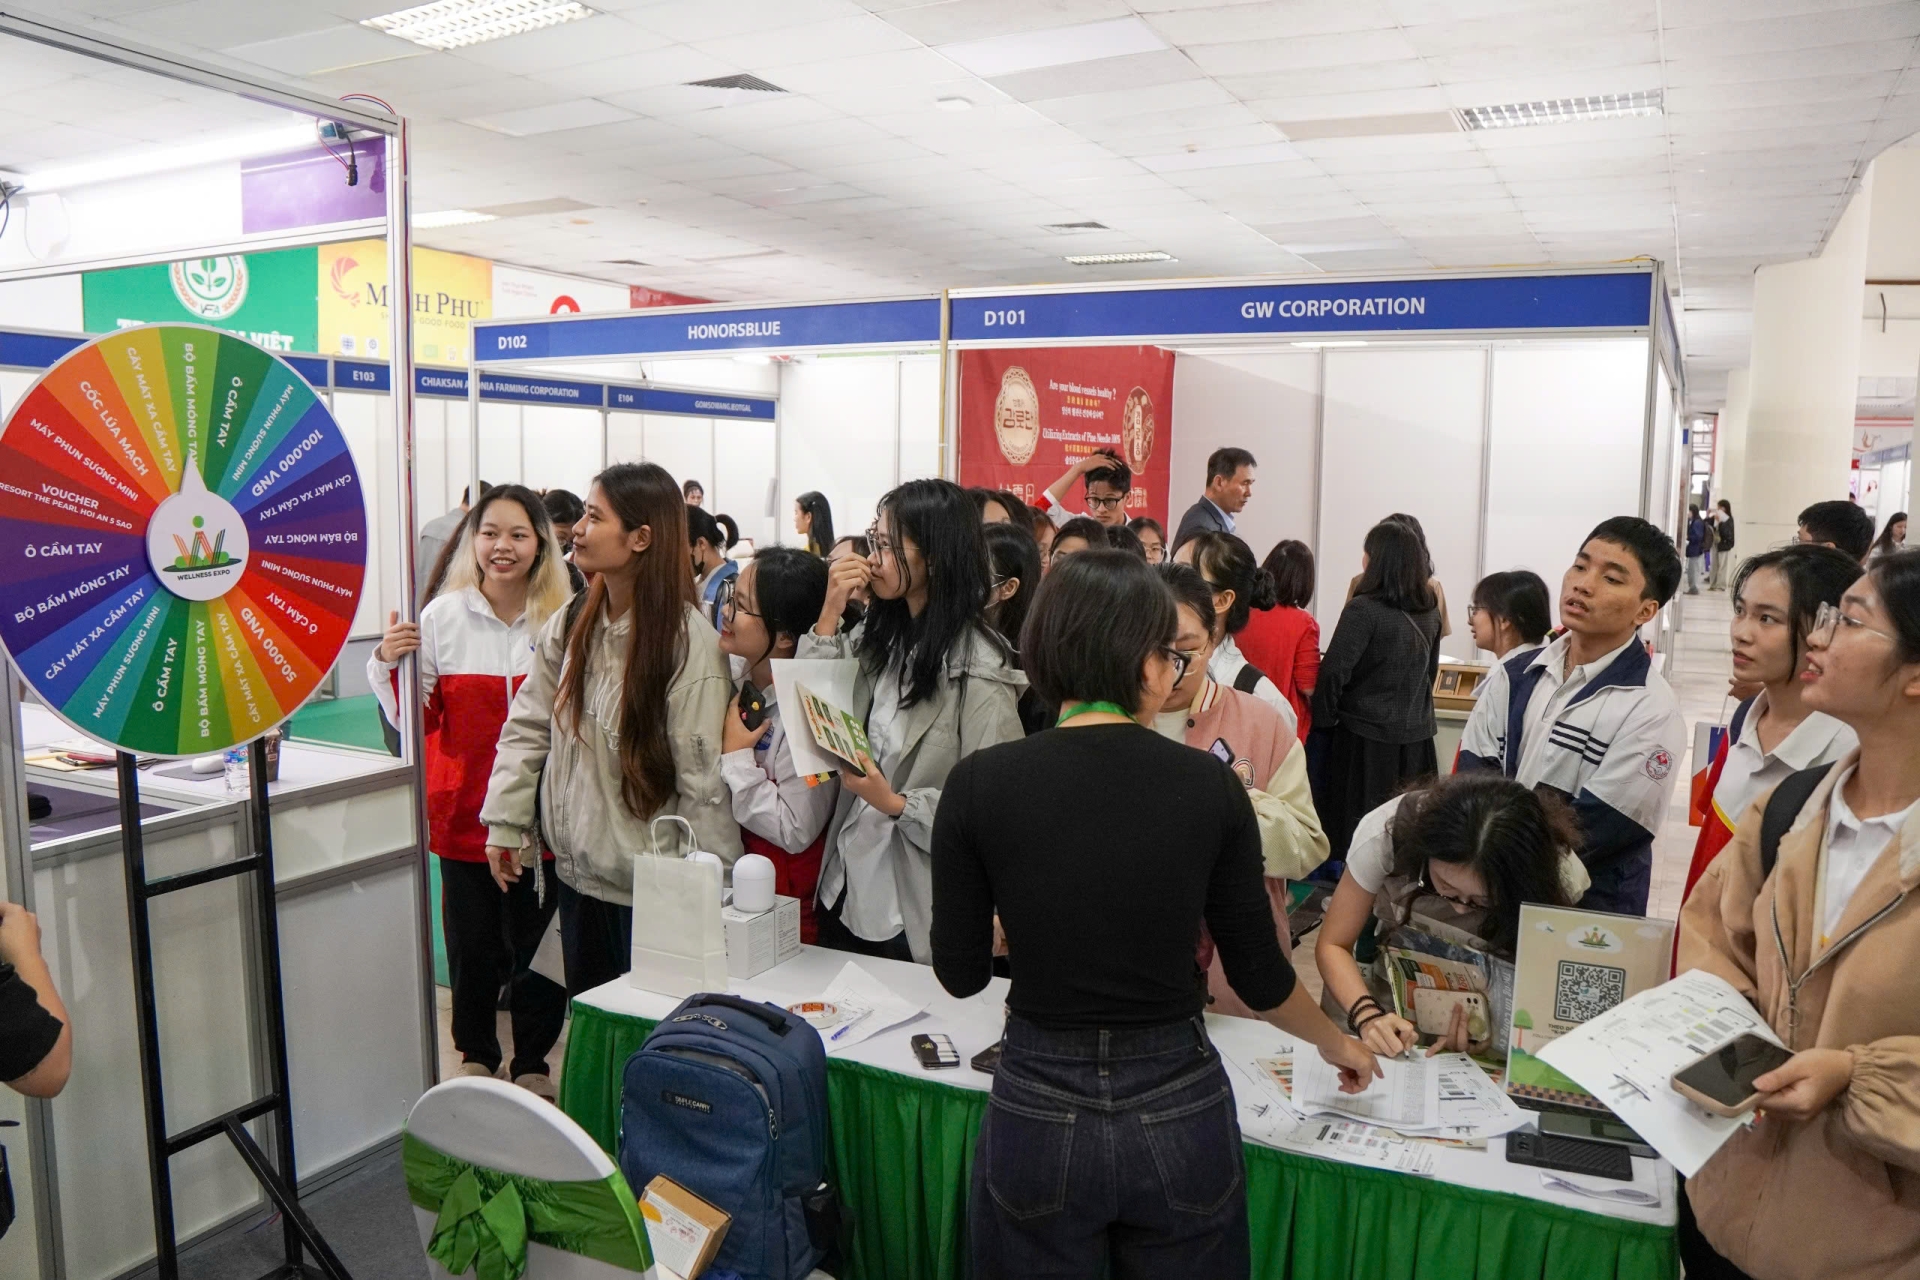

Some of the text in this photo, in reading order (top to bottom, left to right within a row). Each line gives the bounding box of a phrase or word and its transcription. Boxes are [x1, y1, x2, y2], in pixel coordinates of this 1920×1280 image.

[366, 282, 430, 313] MH
[1240, 297, 1426, 319] GW CORPORATION
[984, 310, 1026, 327] D101
[688, 321, 781, 340] HONORSBLUE
[183, 343, 196, 362] BỘ
[498, 335, 528, 350] D102
[185, 365, 198, 395] BẤM
[232, 376, 243, 387] Ô
[352, 370, 375, 382] E103
[421, 376, 580, 398] CHIAKSAN ANIA FARMING CORPORATION
[127, 347, 142, 372] CÂY
[136, 374, 152, 399] MÁT
[146, 402, 158, 420] XA
[162, 450, 178, 473] TAY
[186, 398, 200, 438] MÓNG
[80, 381, 150, 476] CỐC LÚA MẠCH
[217, 422, 230, 448] TAY
[232, 384, 295, 482] MÁY PHUN SƯƠNG MINI
[30, 418, 139, 502] MÁY PHUN SƯƠNG MINI
[252, 428, 324, 497] 100.000 VNĐ
[314, 481, 334, 496] MÁT
[334, 474, 352, 489] CÂY
[0, 482, 33, 498] RESORT
[34, 493, 51, 504] THE
[52, 500, 79, 513] PEARL
[80, 508, 96, 518] HOI
[96, 513, 108, 522] AN
[116, 519, 132, 530] SAO
[42, 482, 100, 510] VOUCHER
[300, 492, 314, 502] XA
[260, 507, 278, 522] TAY
[264, 530, 358, 545] BỘ BẤM MÓNG TAY
[25, 542, 103, 558] Ô CẦM TAY
[177, 571, 212, 581] WELLNESS
[261, 560, 353, 598] MÁY PHUN SƯƠNG MINI
[14, 564, 130, 624] BỘ BẤM MÓNG TAY
[266, 592, 287, 611] TAY
[45, 588, 146, 680] CÂY MÁT XA CẦM TAY
[216, 612, 230, 634] TAY
[308, 624, 318, 635] Ô
[240, 607, 298, 684] 50.000 VNĐ
[92, 606, 160, 719] MÁY PHUN SƯƠNG MINI
[234, 660, 245, 676] XA
[152, 637, 178, 712] Ô CẦM TAY
[196, 620, 212, 738] BỘ BẤM MÓNG TAY
[240, 678, 254, 700] MÁT
[247, 702, 262, 724] CÂY
